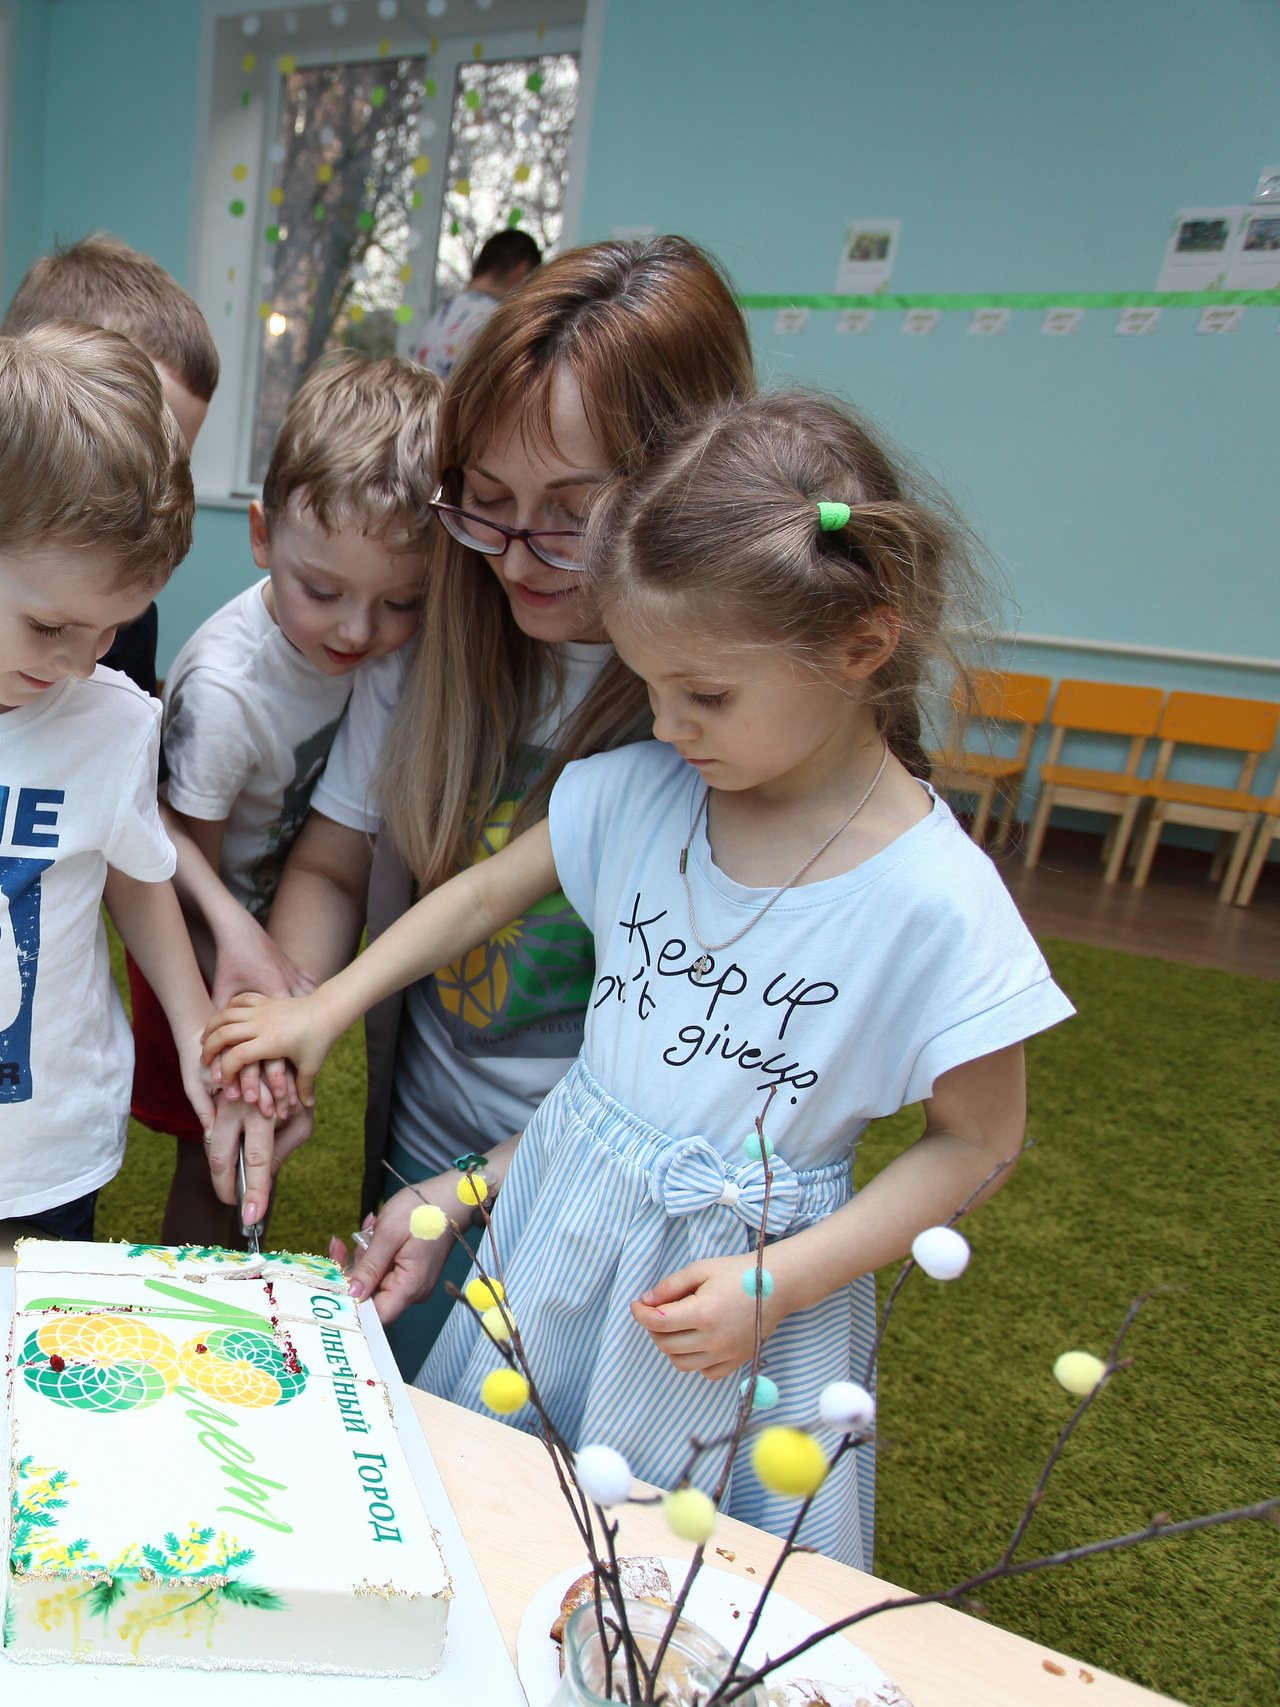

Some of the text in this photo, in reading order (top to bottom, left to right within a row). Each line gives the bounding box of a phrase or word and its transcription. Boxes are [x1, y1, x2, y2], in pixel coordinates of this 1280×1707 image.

[619, 893, 839, 1040] Keep up
[540, 1020, 583, 1036] KRASN
